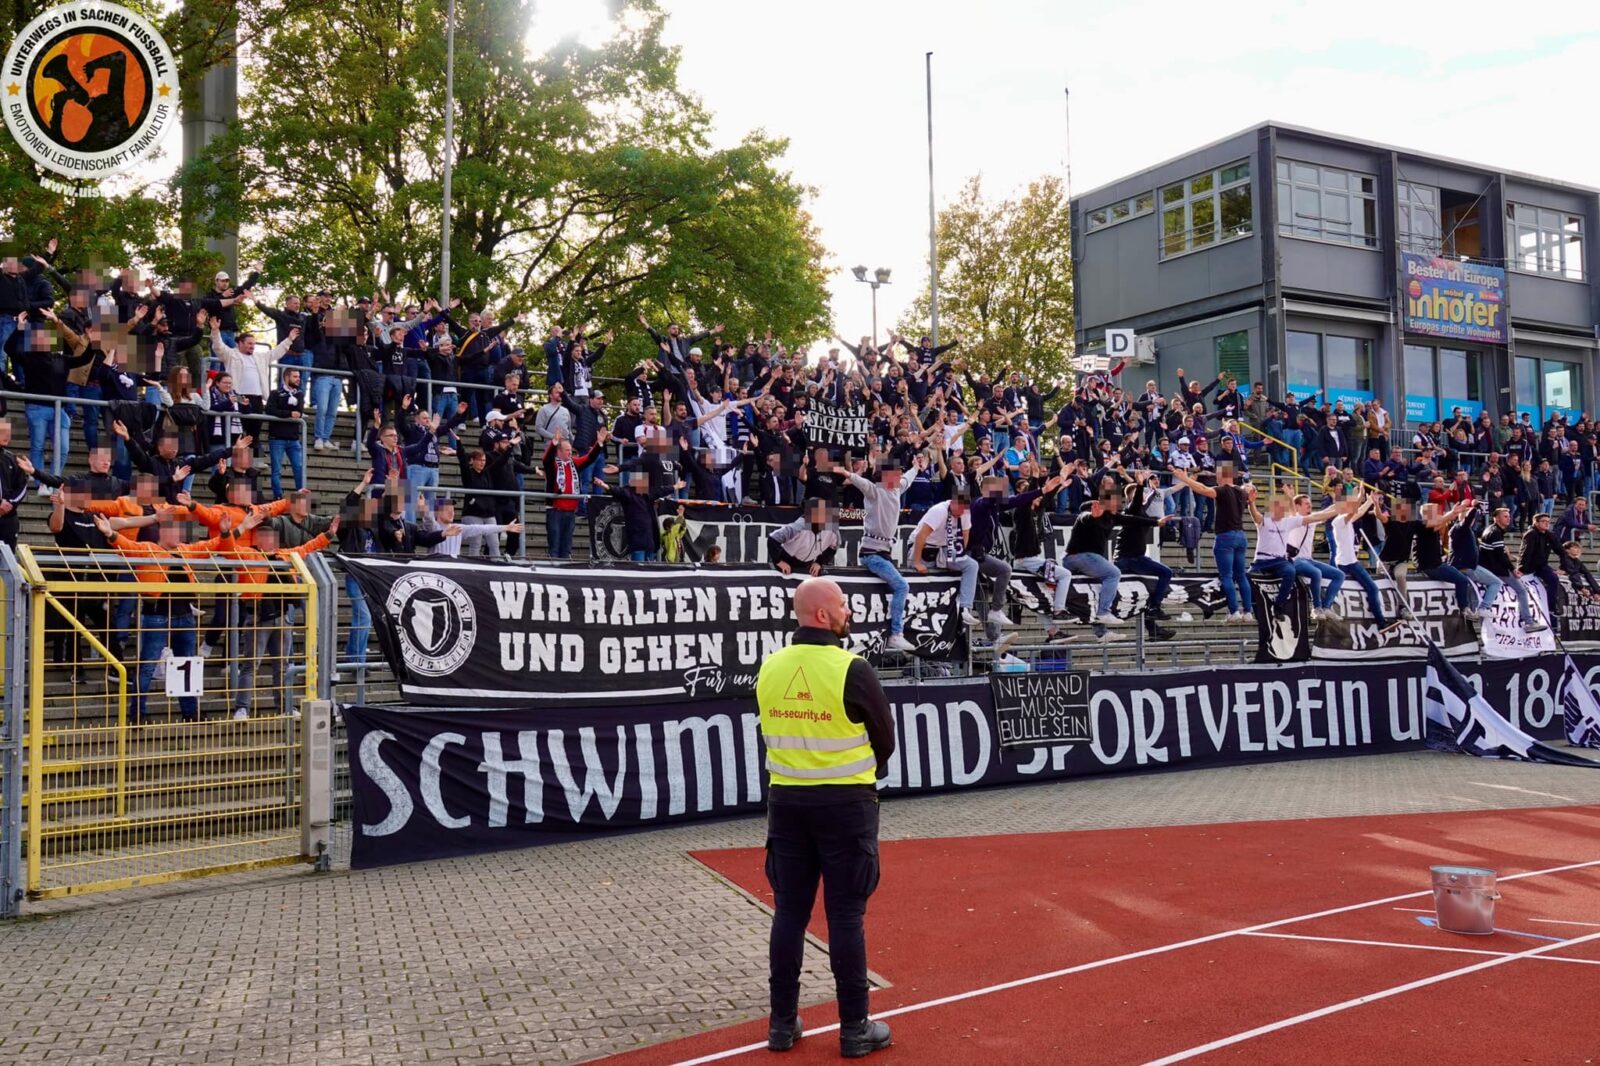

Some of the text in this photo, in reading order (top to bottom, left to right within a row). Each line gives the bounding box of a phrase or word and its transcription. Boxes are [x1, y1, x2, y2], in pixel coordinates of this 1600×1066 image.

[1408, 260, 1444, 279] Bester
[1463, 269, 1500, 289] Europa
[1409, 281, 1500, 327] inhofer
[1409, 318, 1440, 333] Europas
[1112, 333, 1129, 352] D
[810, 412, 866, 432] SOCIETY
[810, 428, 866, 448] ULTRAS
[489, 581, 571, 622] WIR
[581, 586, 717, 626] HALTEN
[499, 632, 584, 673] UND
[600, 632, 723, 674] GEHEN
[177, 660, 191, 692] 1
[684, 666, 727, 698] Für
[997, 674, 1083, 698] NIEMAND
[768, 706, 832, 723] shs-security.de
[1020, 696, 1065, 718] MUSS
[1000, 715, 1088, 741] BULLE SEIN
